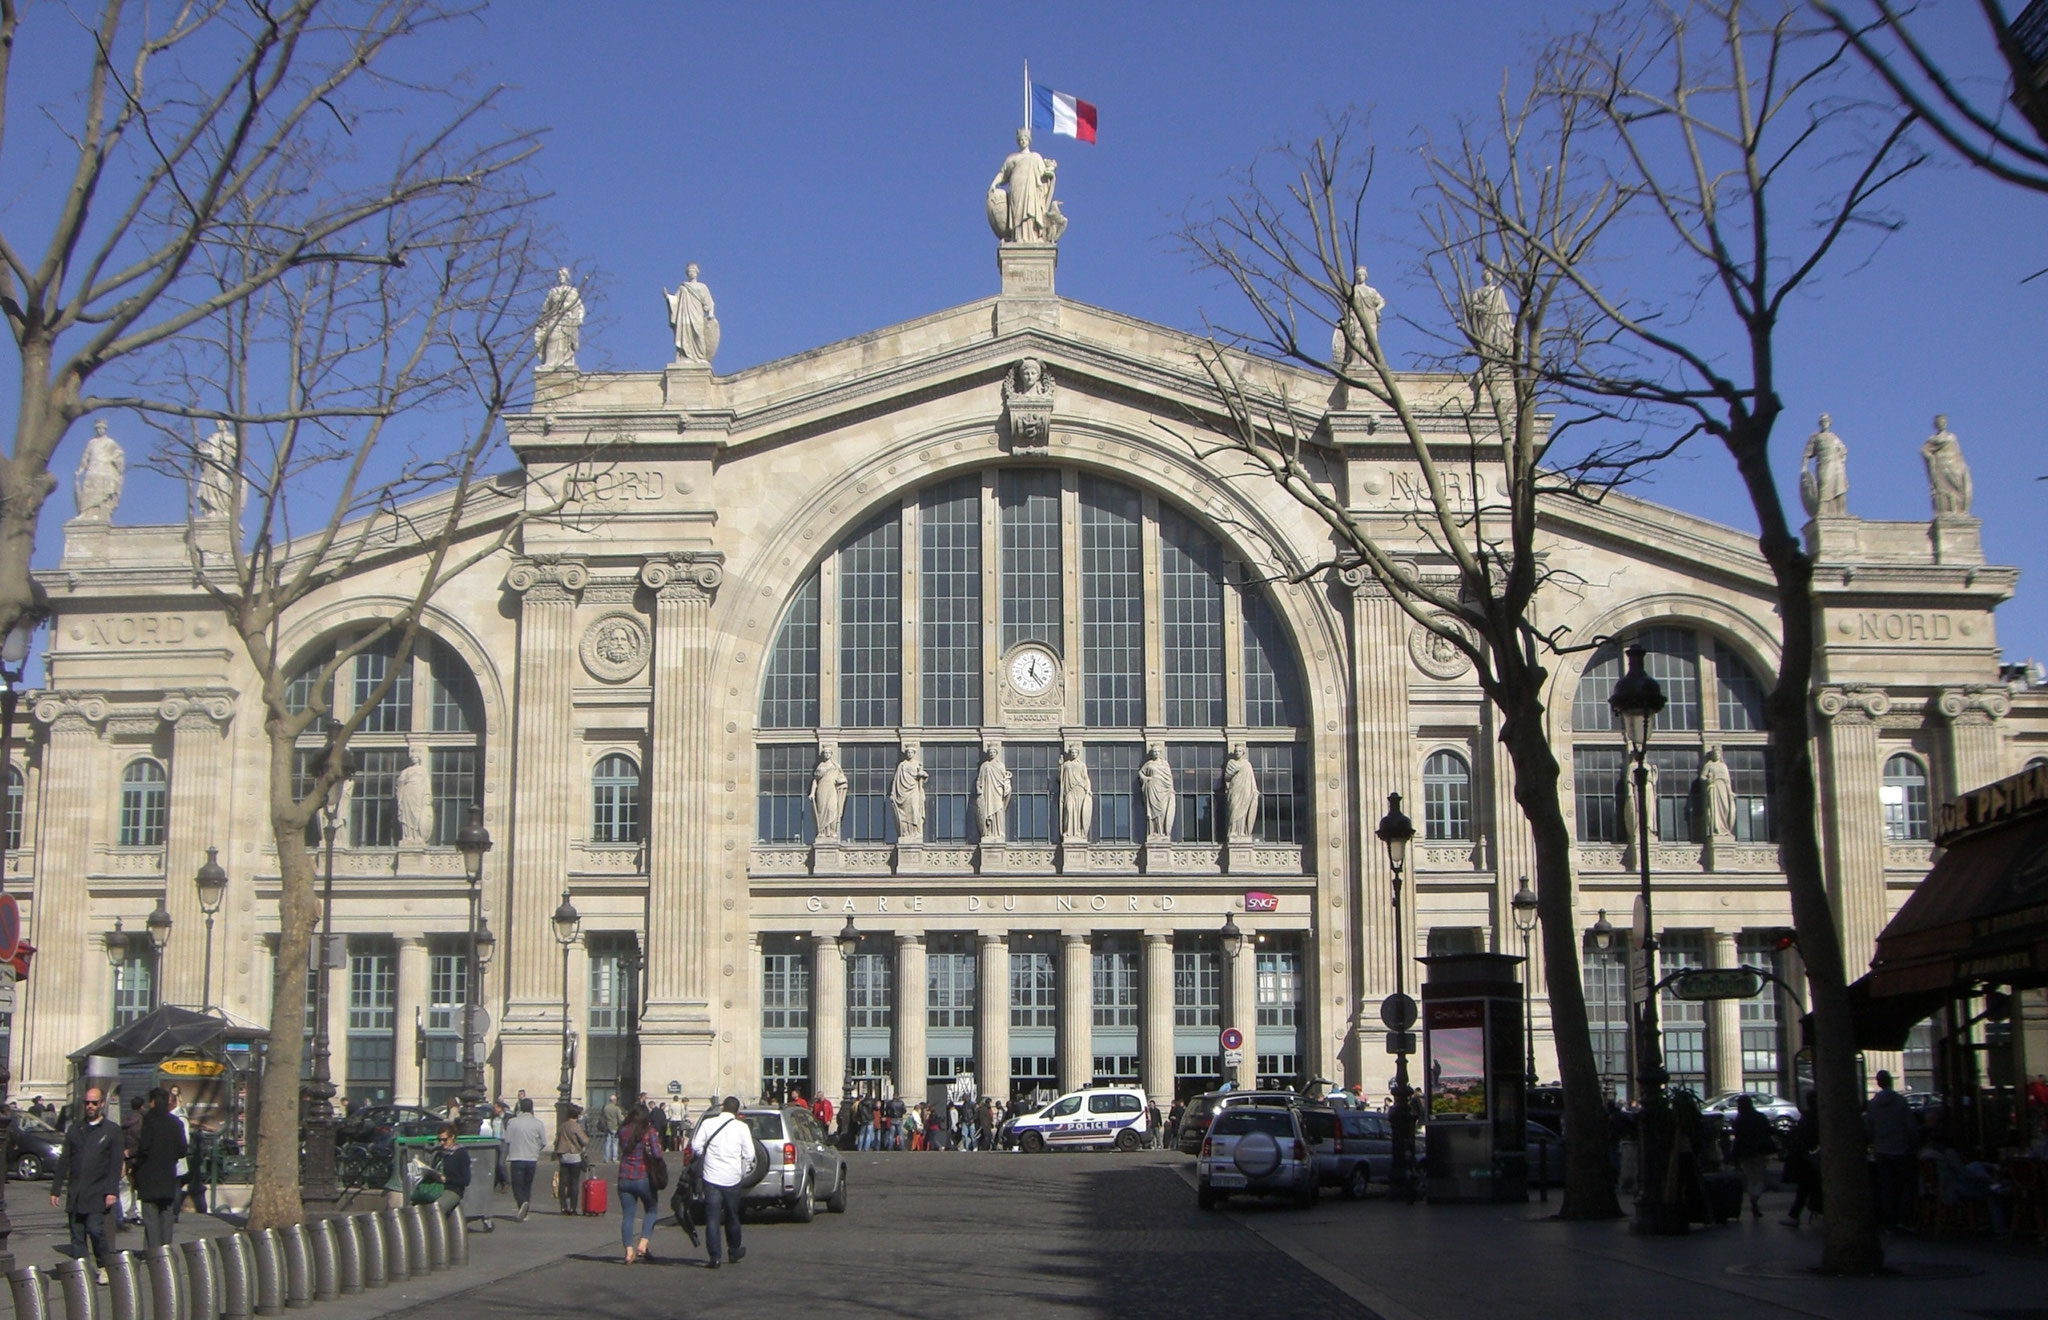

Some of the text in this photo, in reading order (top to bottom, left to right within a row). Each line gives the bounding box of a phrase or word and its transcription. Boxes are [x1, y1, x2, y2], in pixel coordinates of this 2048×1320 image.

[90, 616, 185, 645] NORD
[1859, 613, 1951, 640] NORD
[806, 895, 1174, 912] GARE DU NORD
[1248, 898, 1278, 908] SNCF
[1067, 1121, 1109, 1131] POLICE
